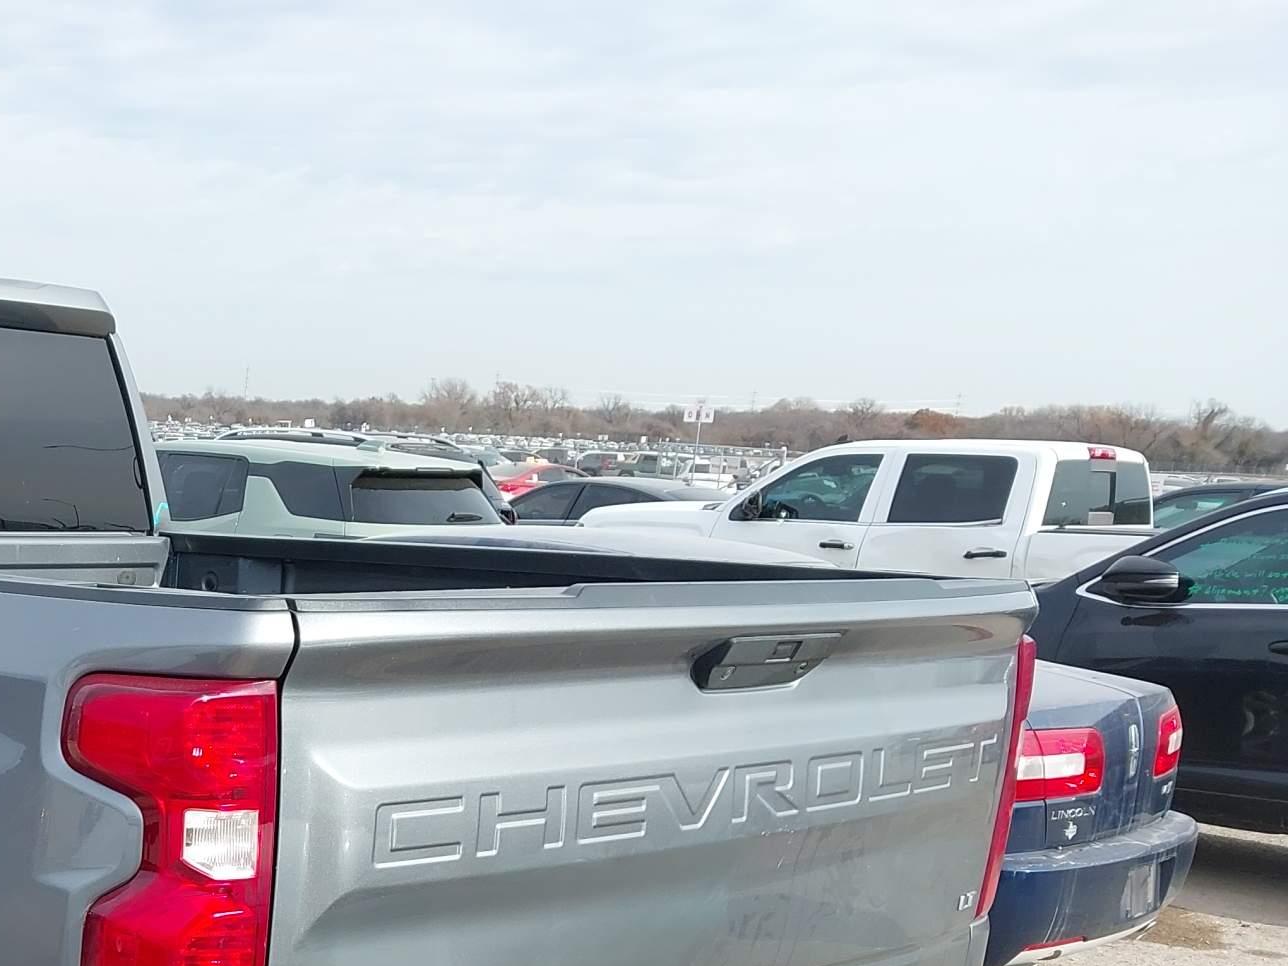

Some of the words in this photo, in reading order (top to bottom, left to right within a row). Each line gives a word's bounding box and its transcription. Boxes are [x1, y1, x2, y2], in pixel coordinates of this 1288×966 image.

[372, 733, 998, 869] CHEVROLET
[1050, 805, 1097, 821] LINCOLN
[956, 890, 978, 912] LT
